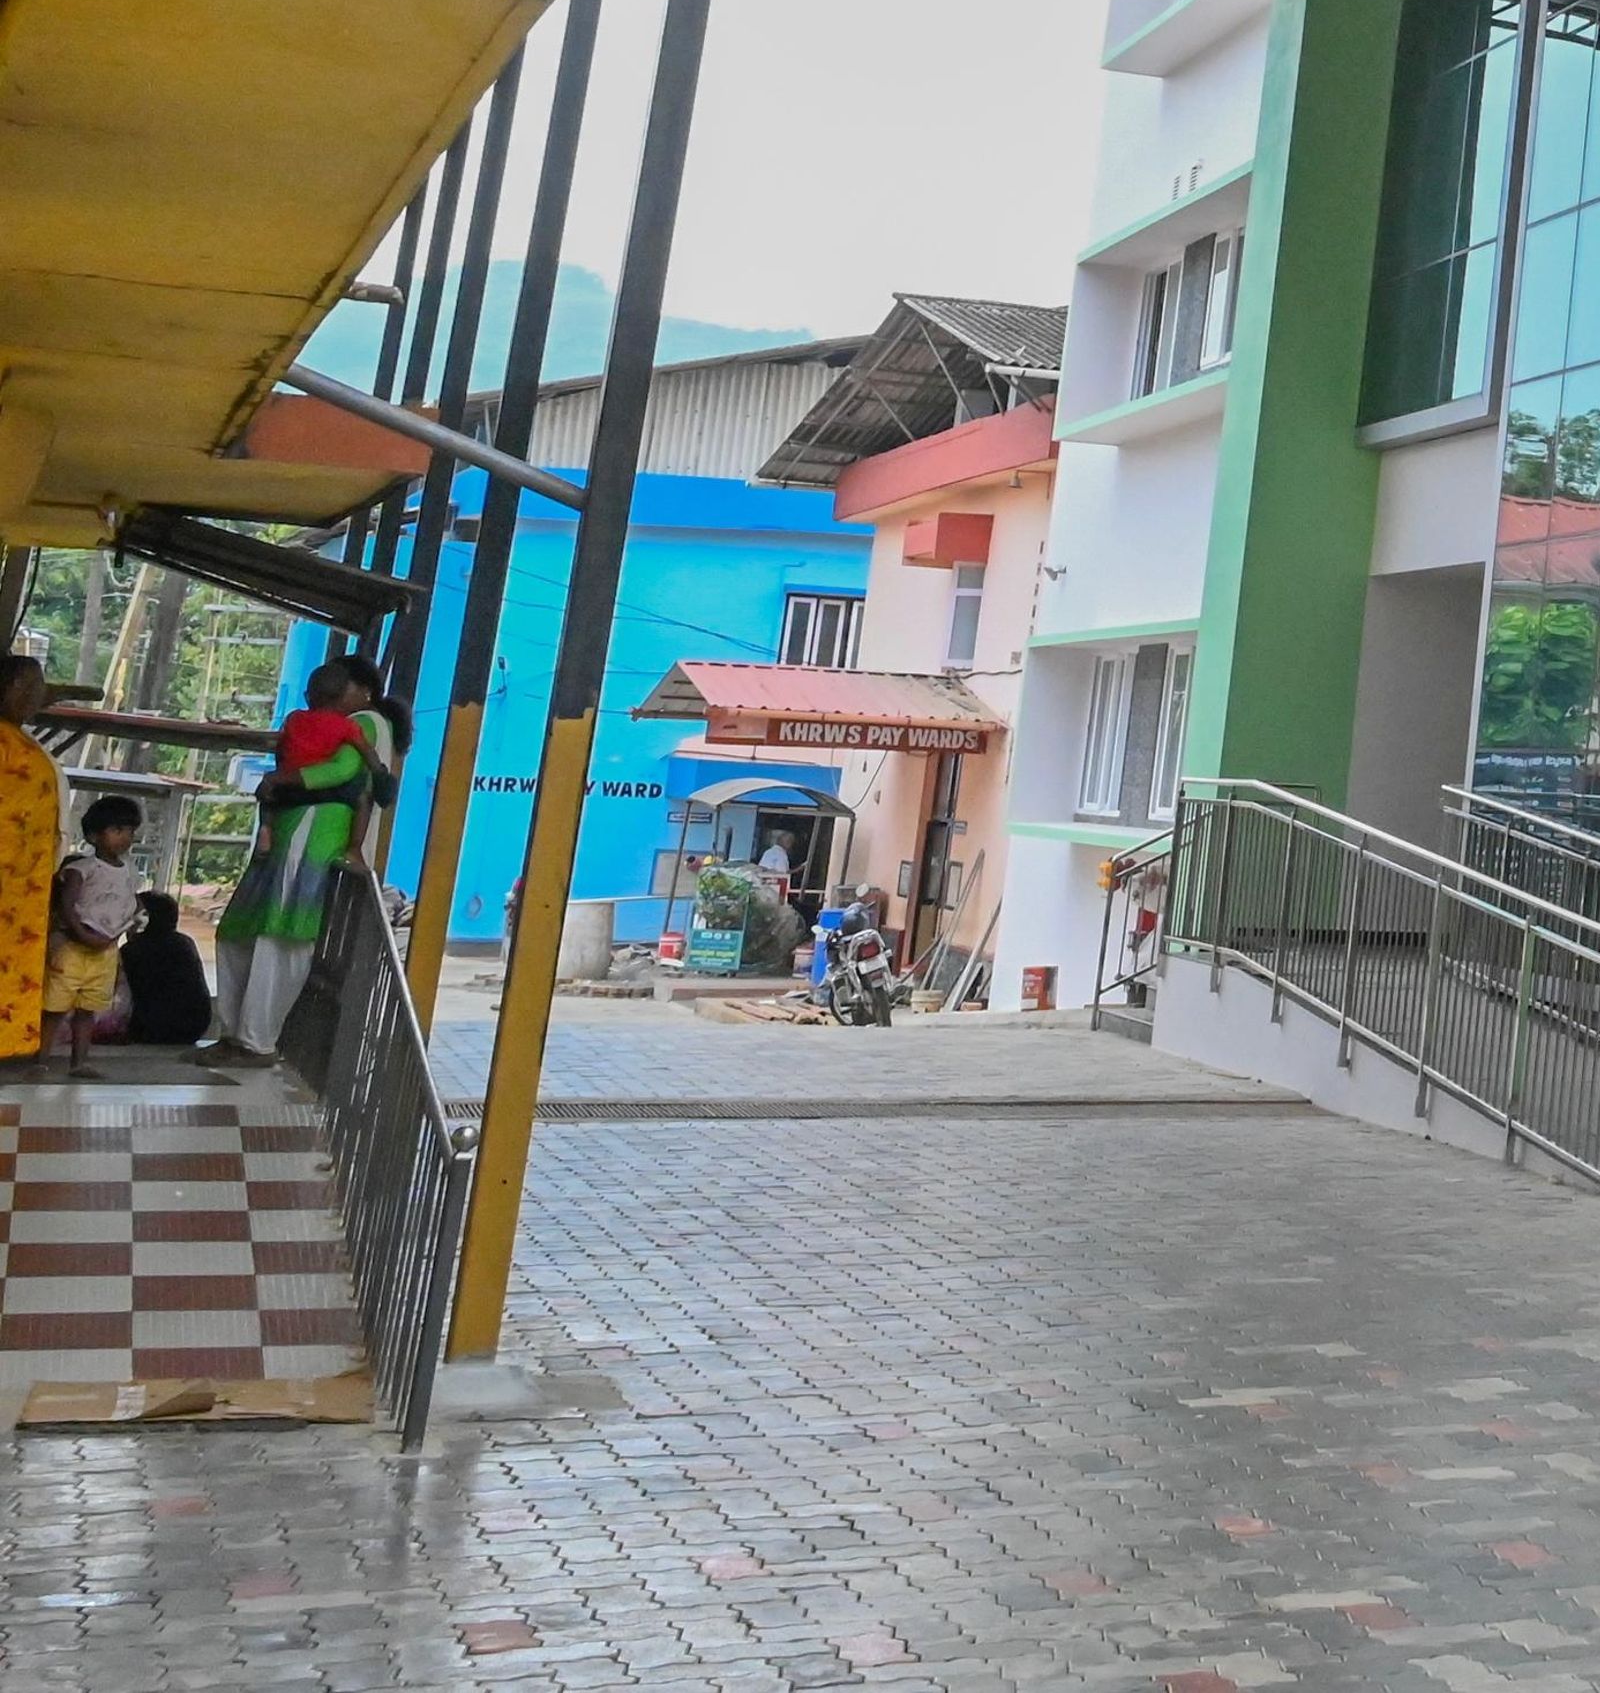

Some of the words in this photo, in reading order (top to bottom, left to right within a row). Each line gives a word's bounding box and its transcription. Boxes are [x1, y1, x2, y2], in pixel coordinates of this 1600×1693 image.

[778, 721, 861, 744] KHRWS
[866, 725, 904, 746] PAY
[908, 727, 979, 749] WARDS
[473, 775, 537, 794] KHRW
[602, 780, 663, 799] WARD
